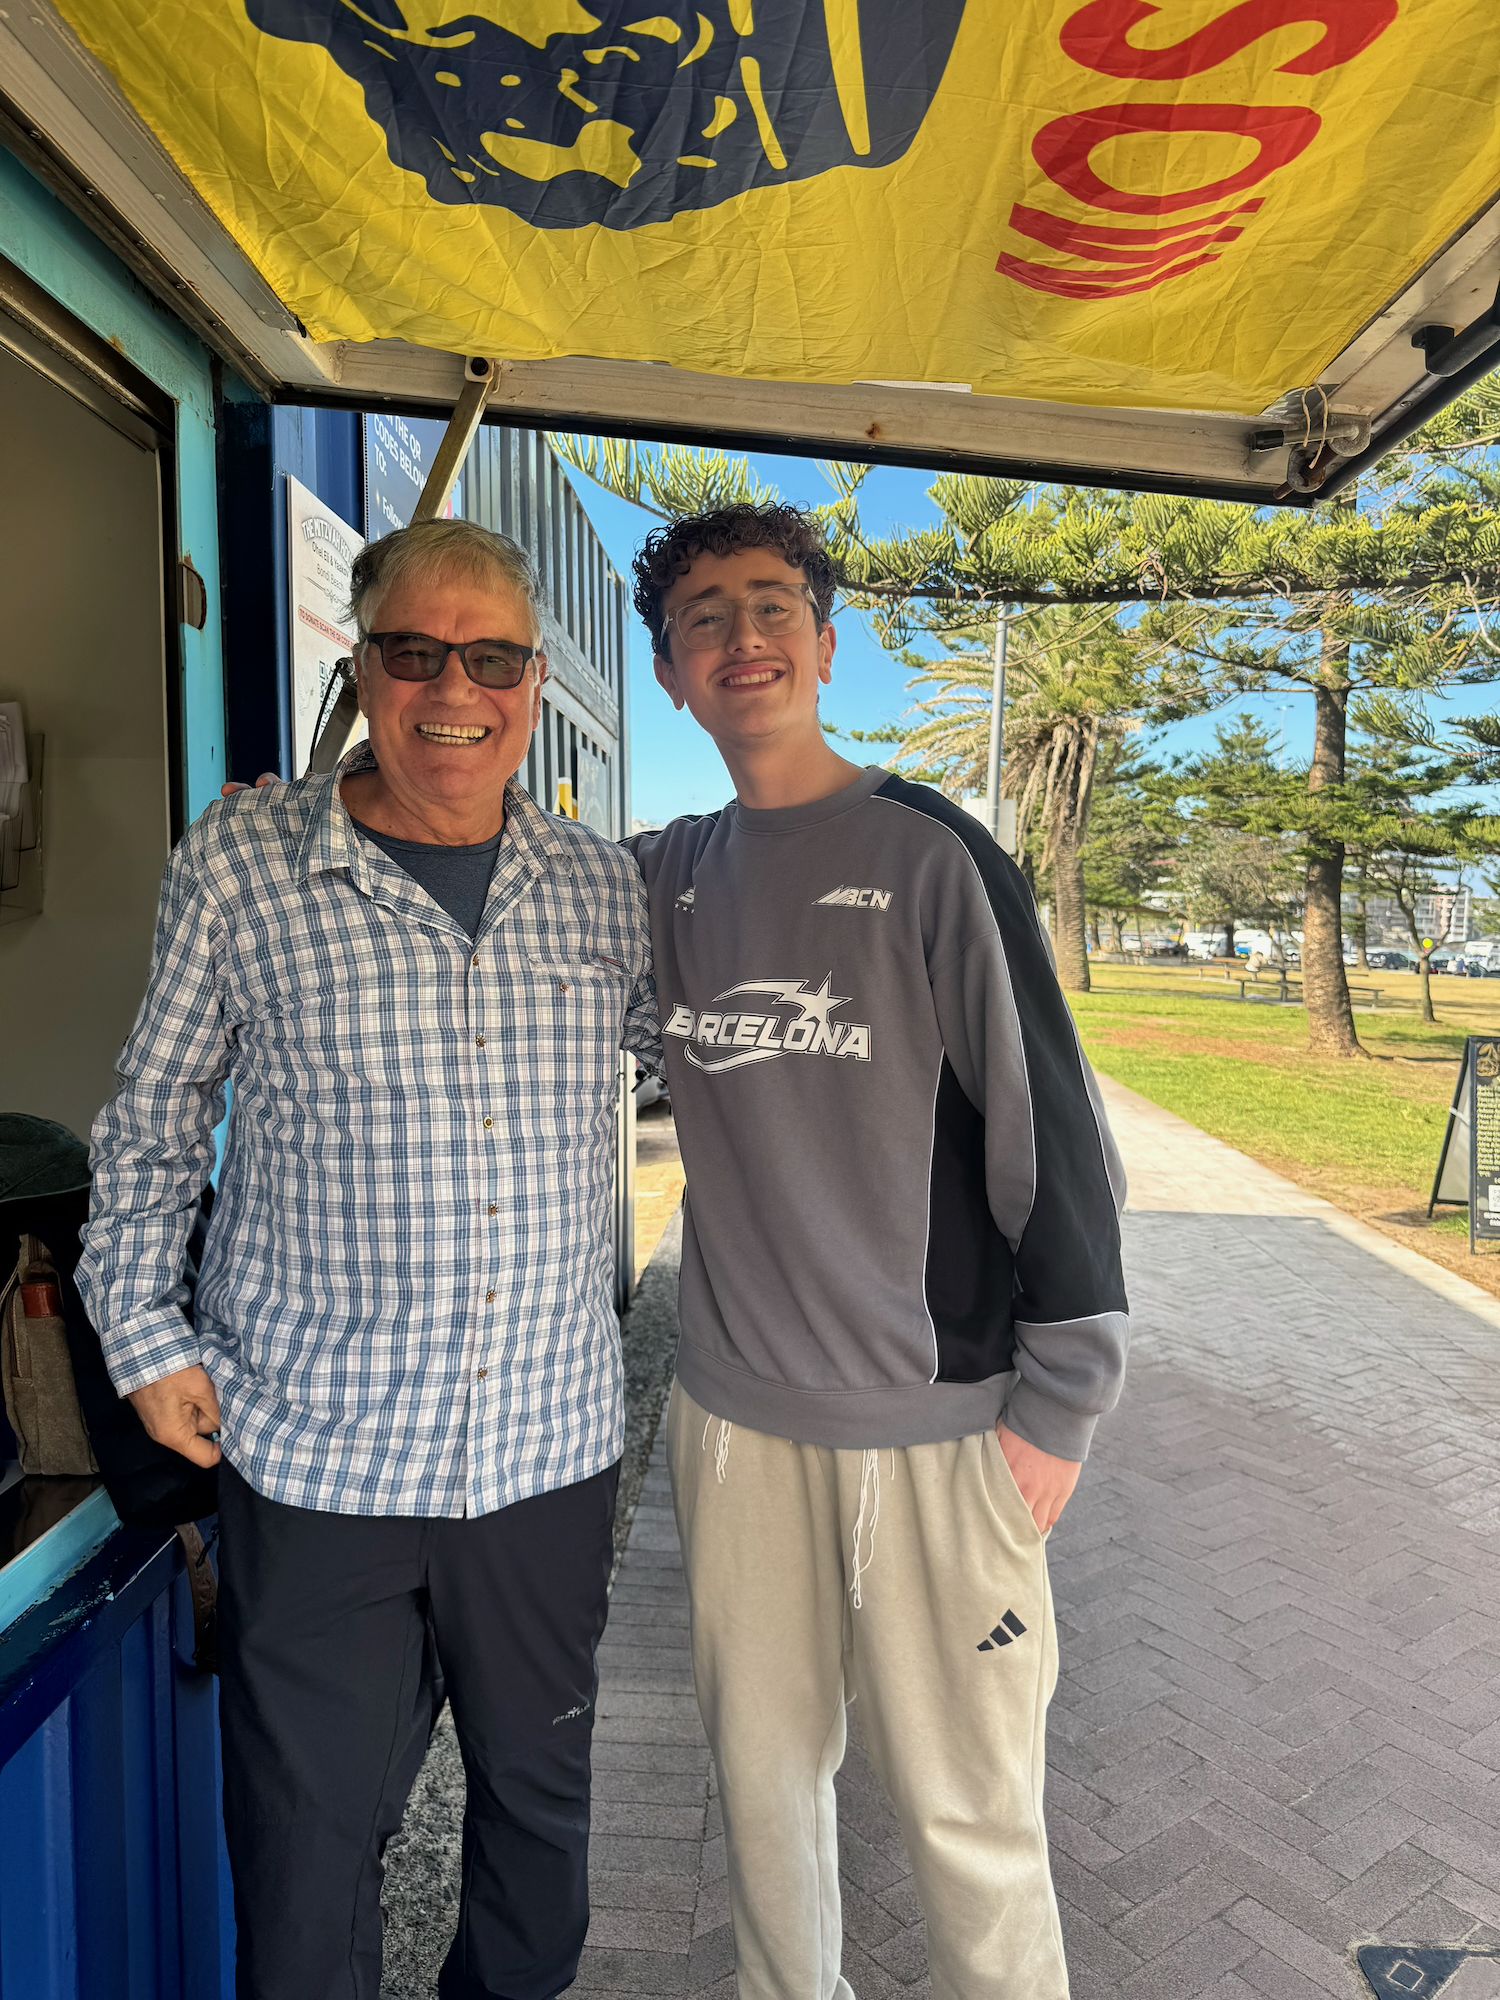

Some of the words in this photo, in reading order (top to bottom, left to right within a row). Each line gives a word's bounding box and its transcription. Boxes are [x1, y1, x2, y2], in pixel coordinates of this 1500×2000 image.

[374, 414, 399, 462] CODES
[395, 416, 409, 447] THE
[409, 433, 421, 462] QR
[374, 442, 387, 477] TO:
[301, 518, 315, 541] THE
[314, 518, 341, 552] MITZVAH
[316, 563, 330, 581] Bondi
[661, 1003, 871, 1061] BRCELONA
